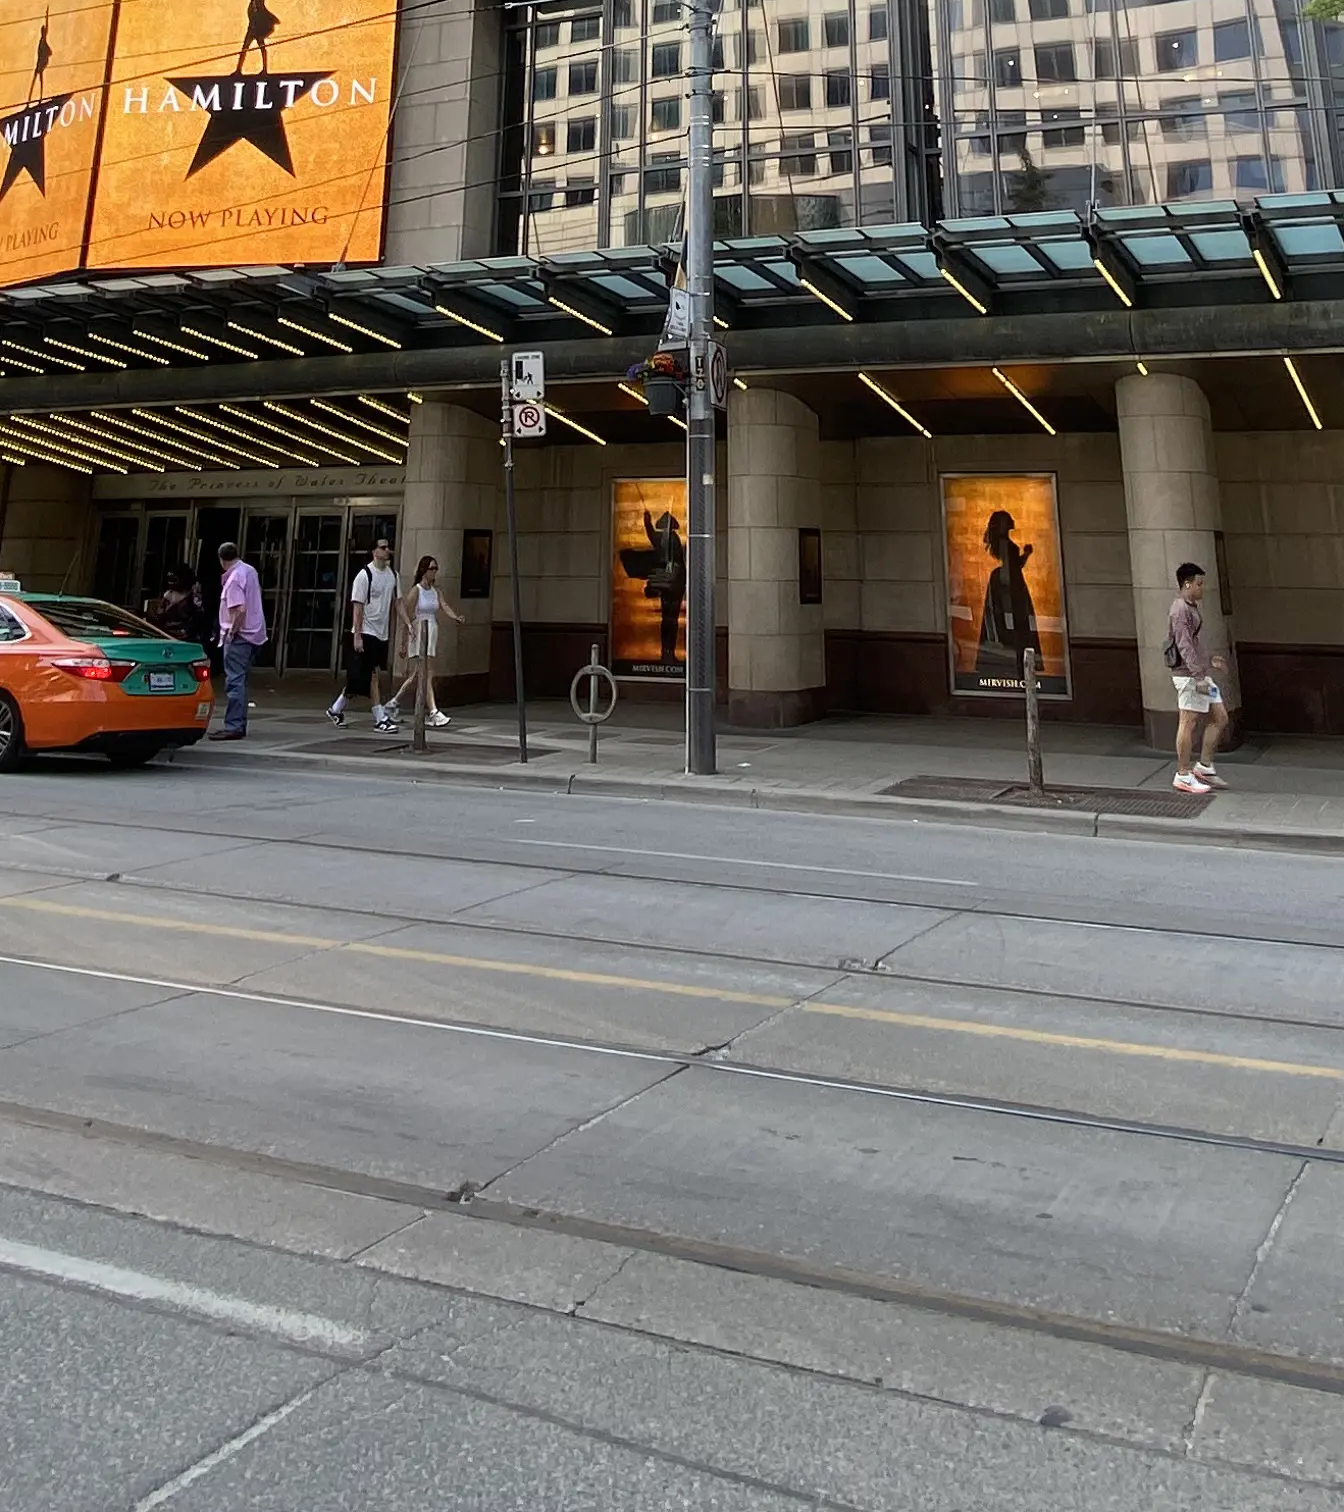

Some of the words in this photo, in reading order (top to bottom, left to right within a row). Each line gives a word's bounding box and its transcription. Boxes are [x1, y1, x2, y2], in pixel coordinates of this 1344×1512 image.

[122, 77, 377, 115] HAMILTON
[147, 210, 213, 231] NOW
[220, 206, 330, 228] PLAYING
[6, 222, 60, 253] PLAYING
[148, 479, 177, 491] The
[268, 476, 286, 489] of
[296, 475, 344, 487] Wales
[354, 472, 407, 486] Theat
[979, 678, 1042, 689] MIRVISH.CM
